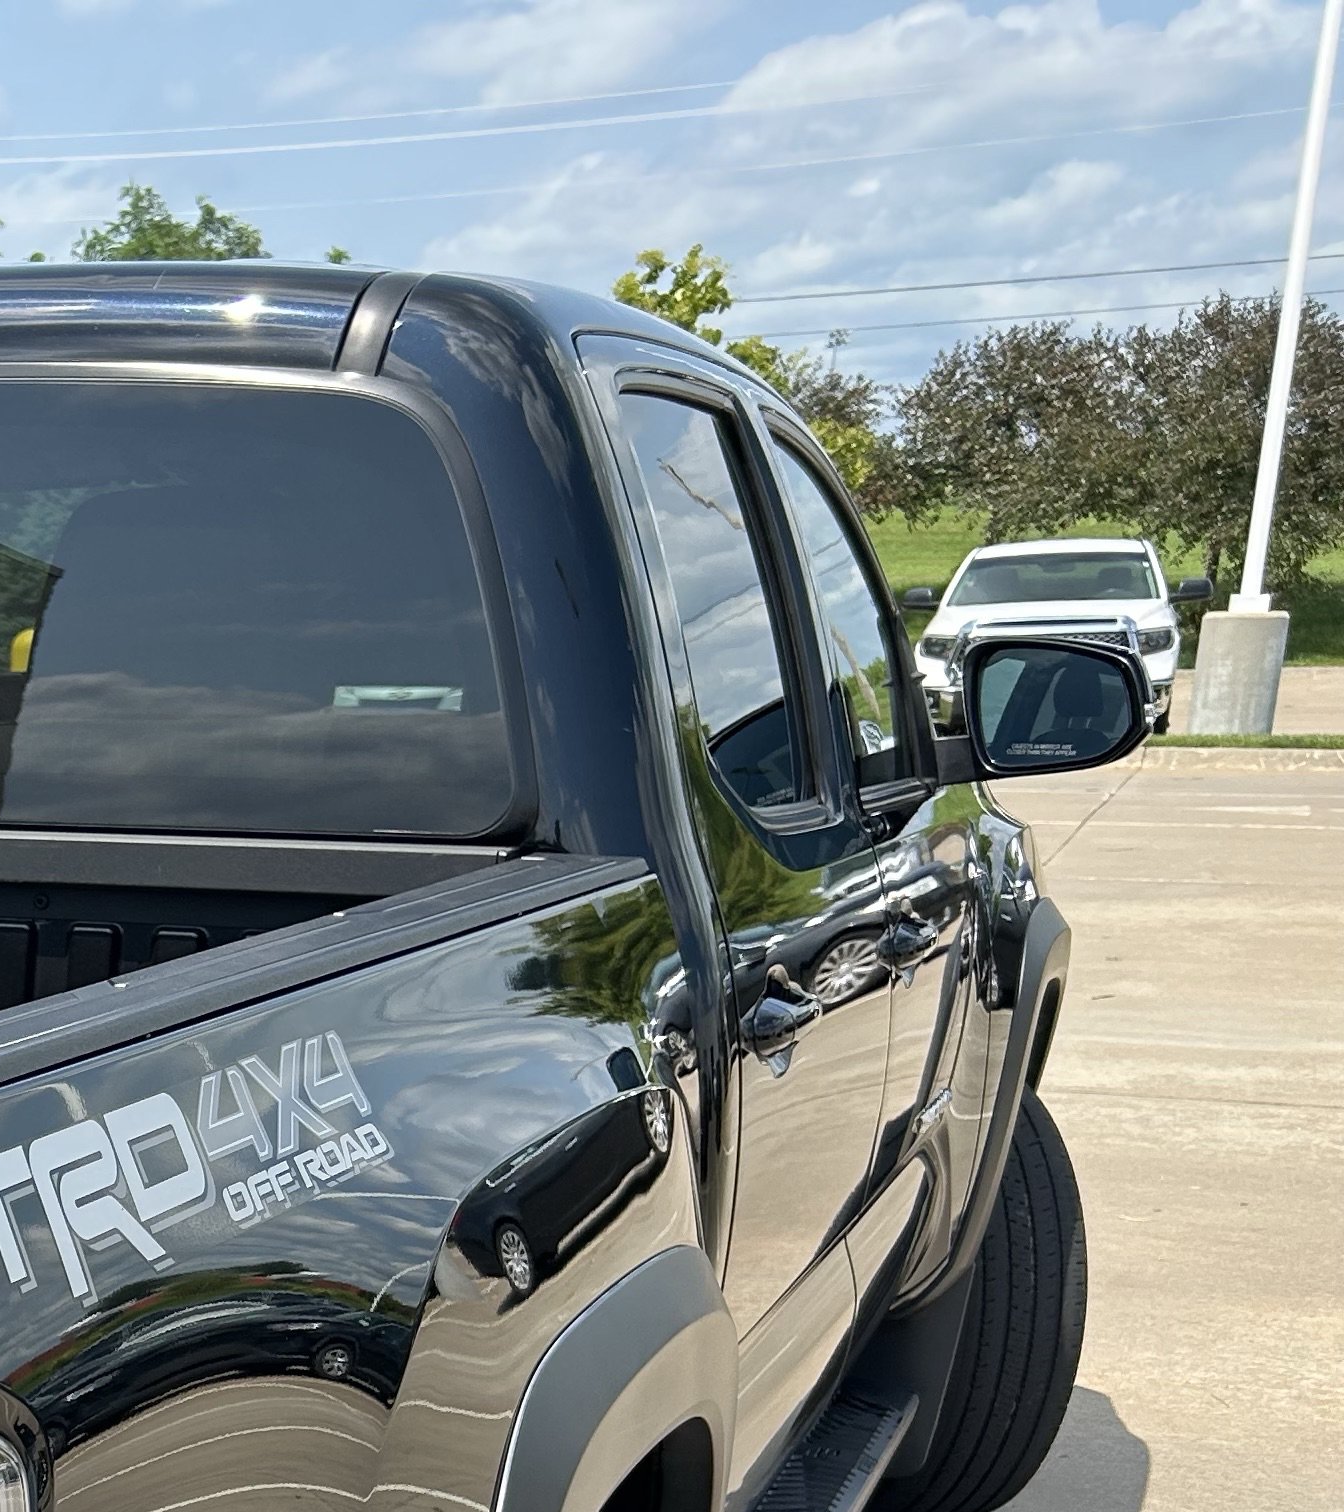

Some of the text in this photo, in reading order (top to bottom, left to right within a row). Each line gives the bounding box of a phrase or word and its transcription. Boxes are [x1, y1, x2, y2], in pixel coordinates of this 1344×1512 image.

[197, 1030, 372, 1162] 4X4
[223, 1122, 391, 1224] OFF ROAD
